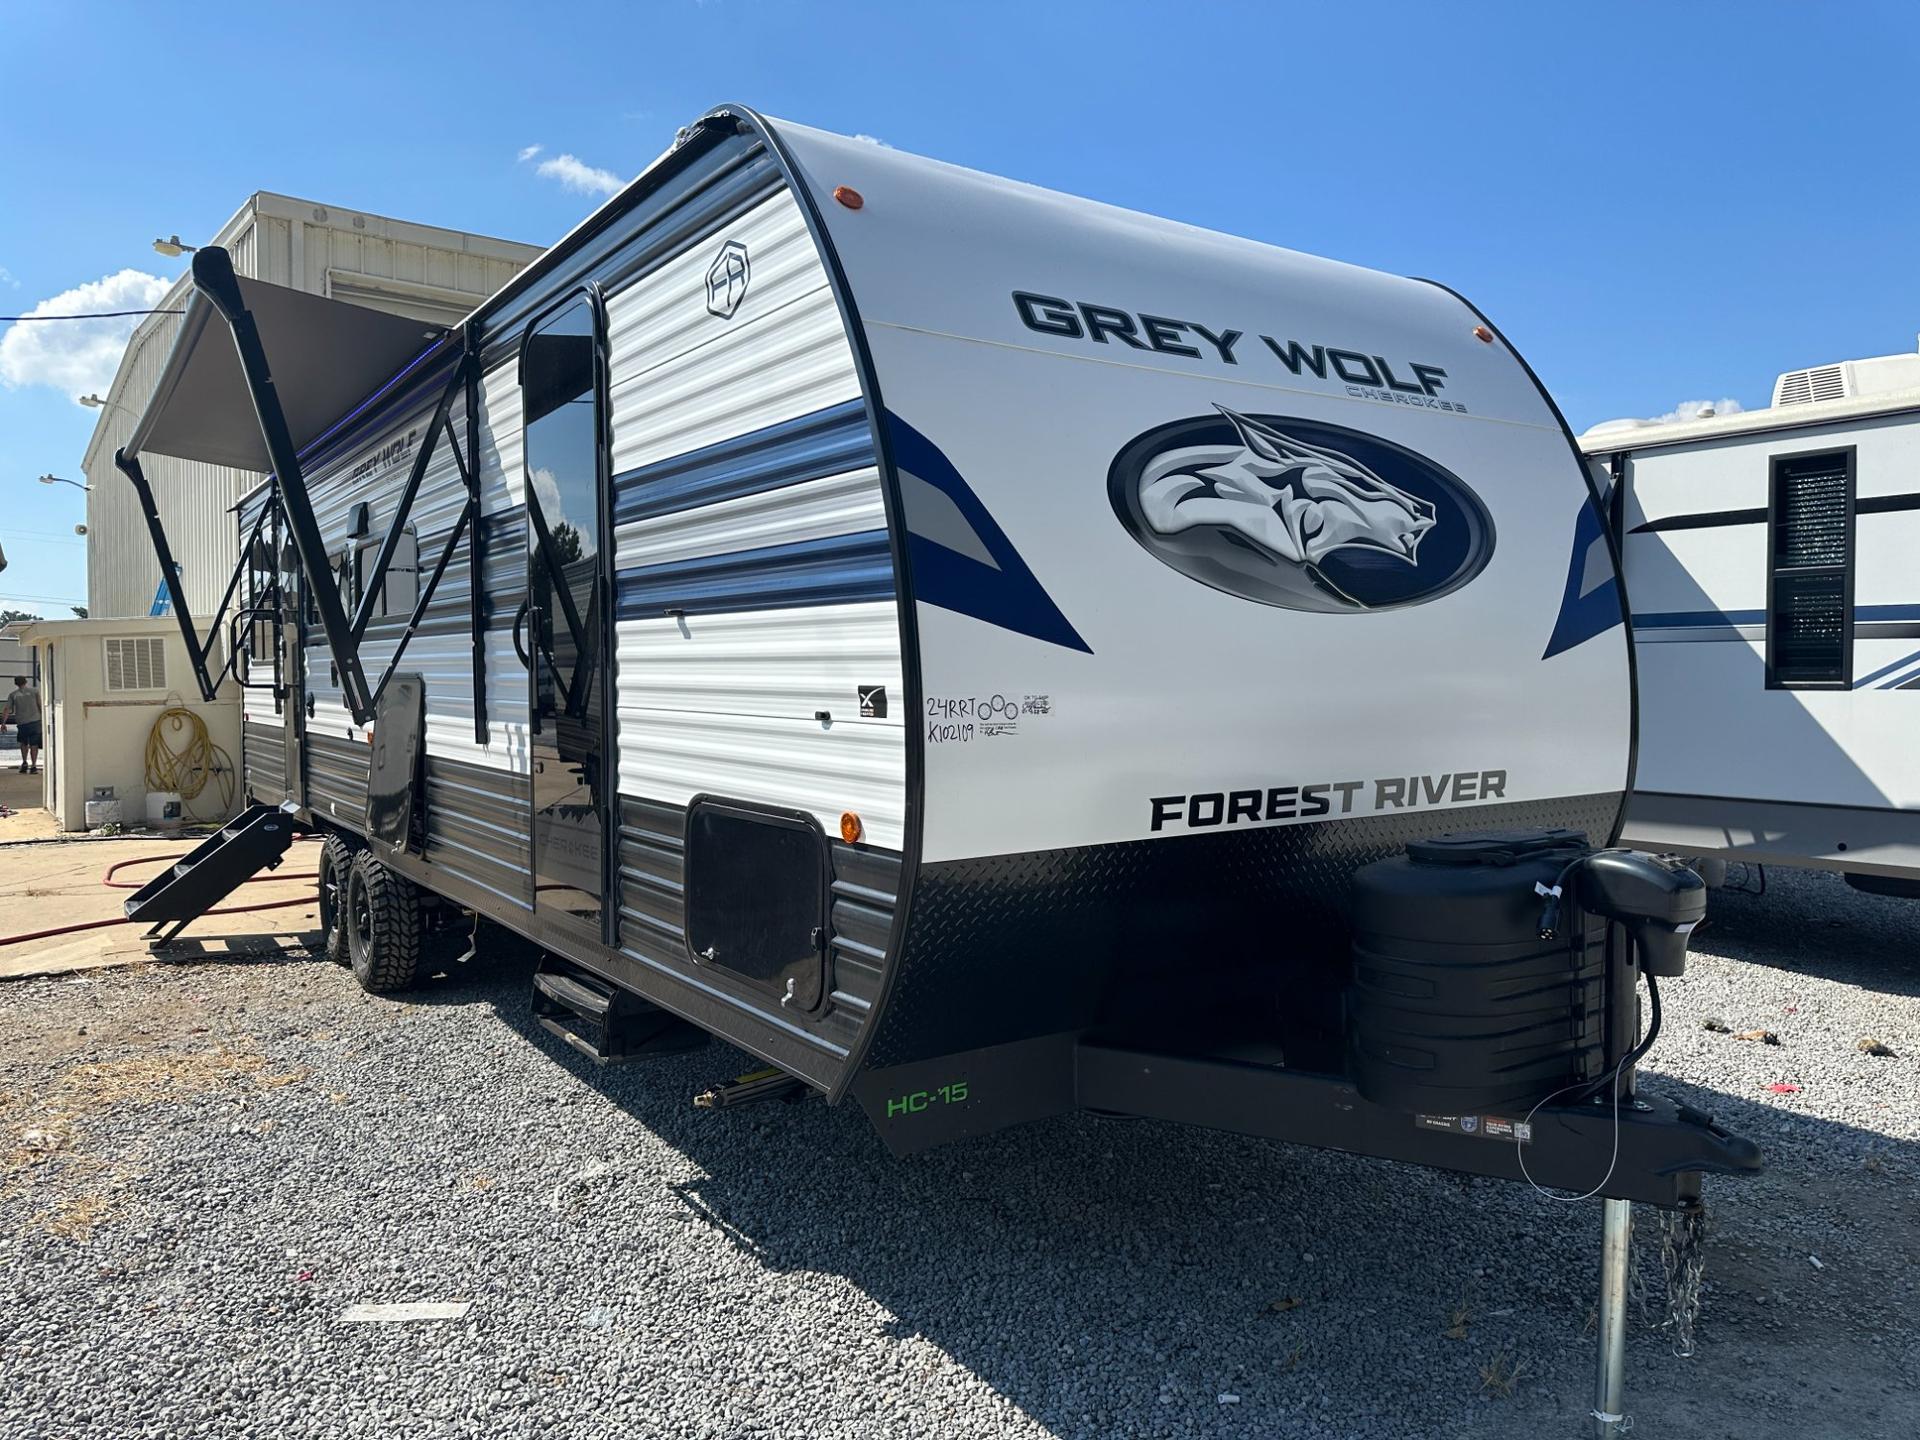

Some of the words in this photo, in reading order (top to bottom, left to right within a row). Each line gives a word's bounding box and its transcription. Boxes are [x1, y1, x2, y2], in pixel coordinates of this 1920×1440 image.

[1010, 289, 1244, 366] GREY
[1258, 334, 1449, 397] WOLF
[1345, 385, 1468, 414] CHEROKEE
[351, 451, 381, 485] GREY
[382, 428, 416, 469] WOLF
[926, 697, 976, 719] 24RRT
[927, 720, 974, 744] K102109
[1149, 781, 1365, 832] FOREST
[1374, 769, 1508, 810] RIVER
[887, 1081, 968, 1118] HC-15
